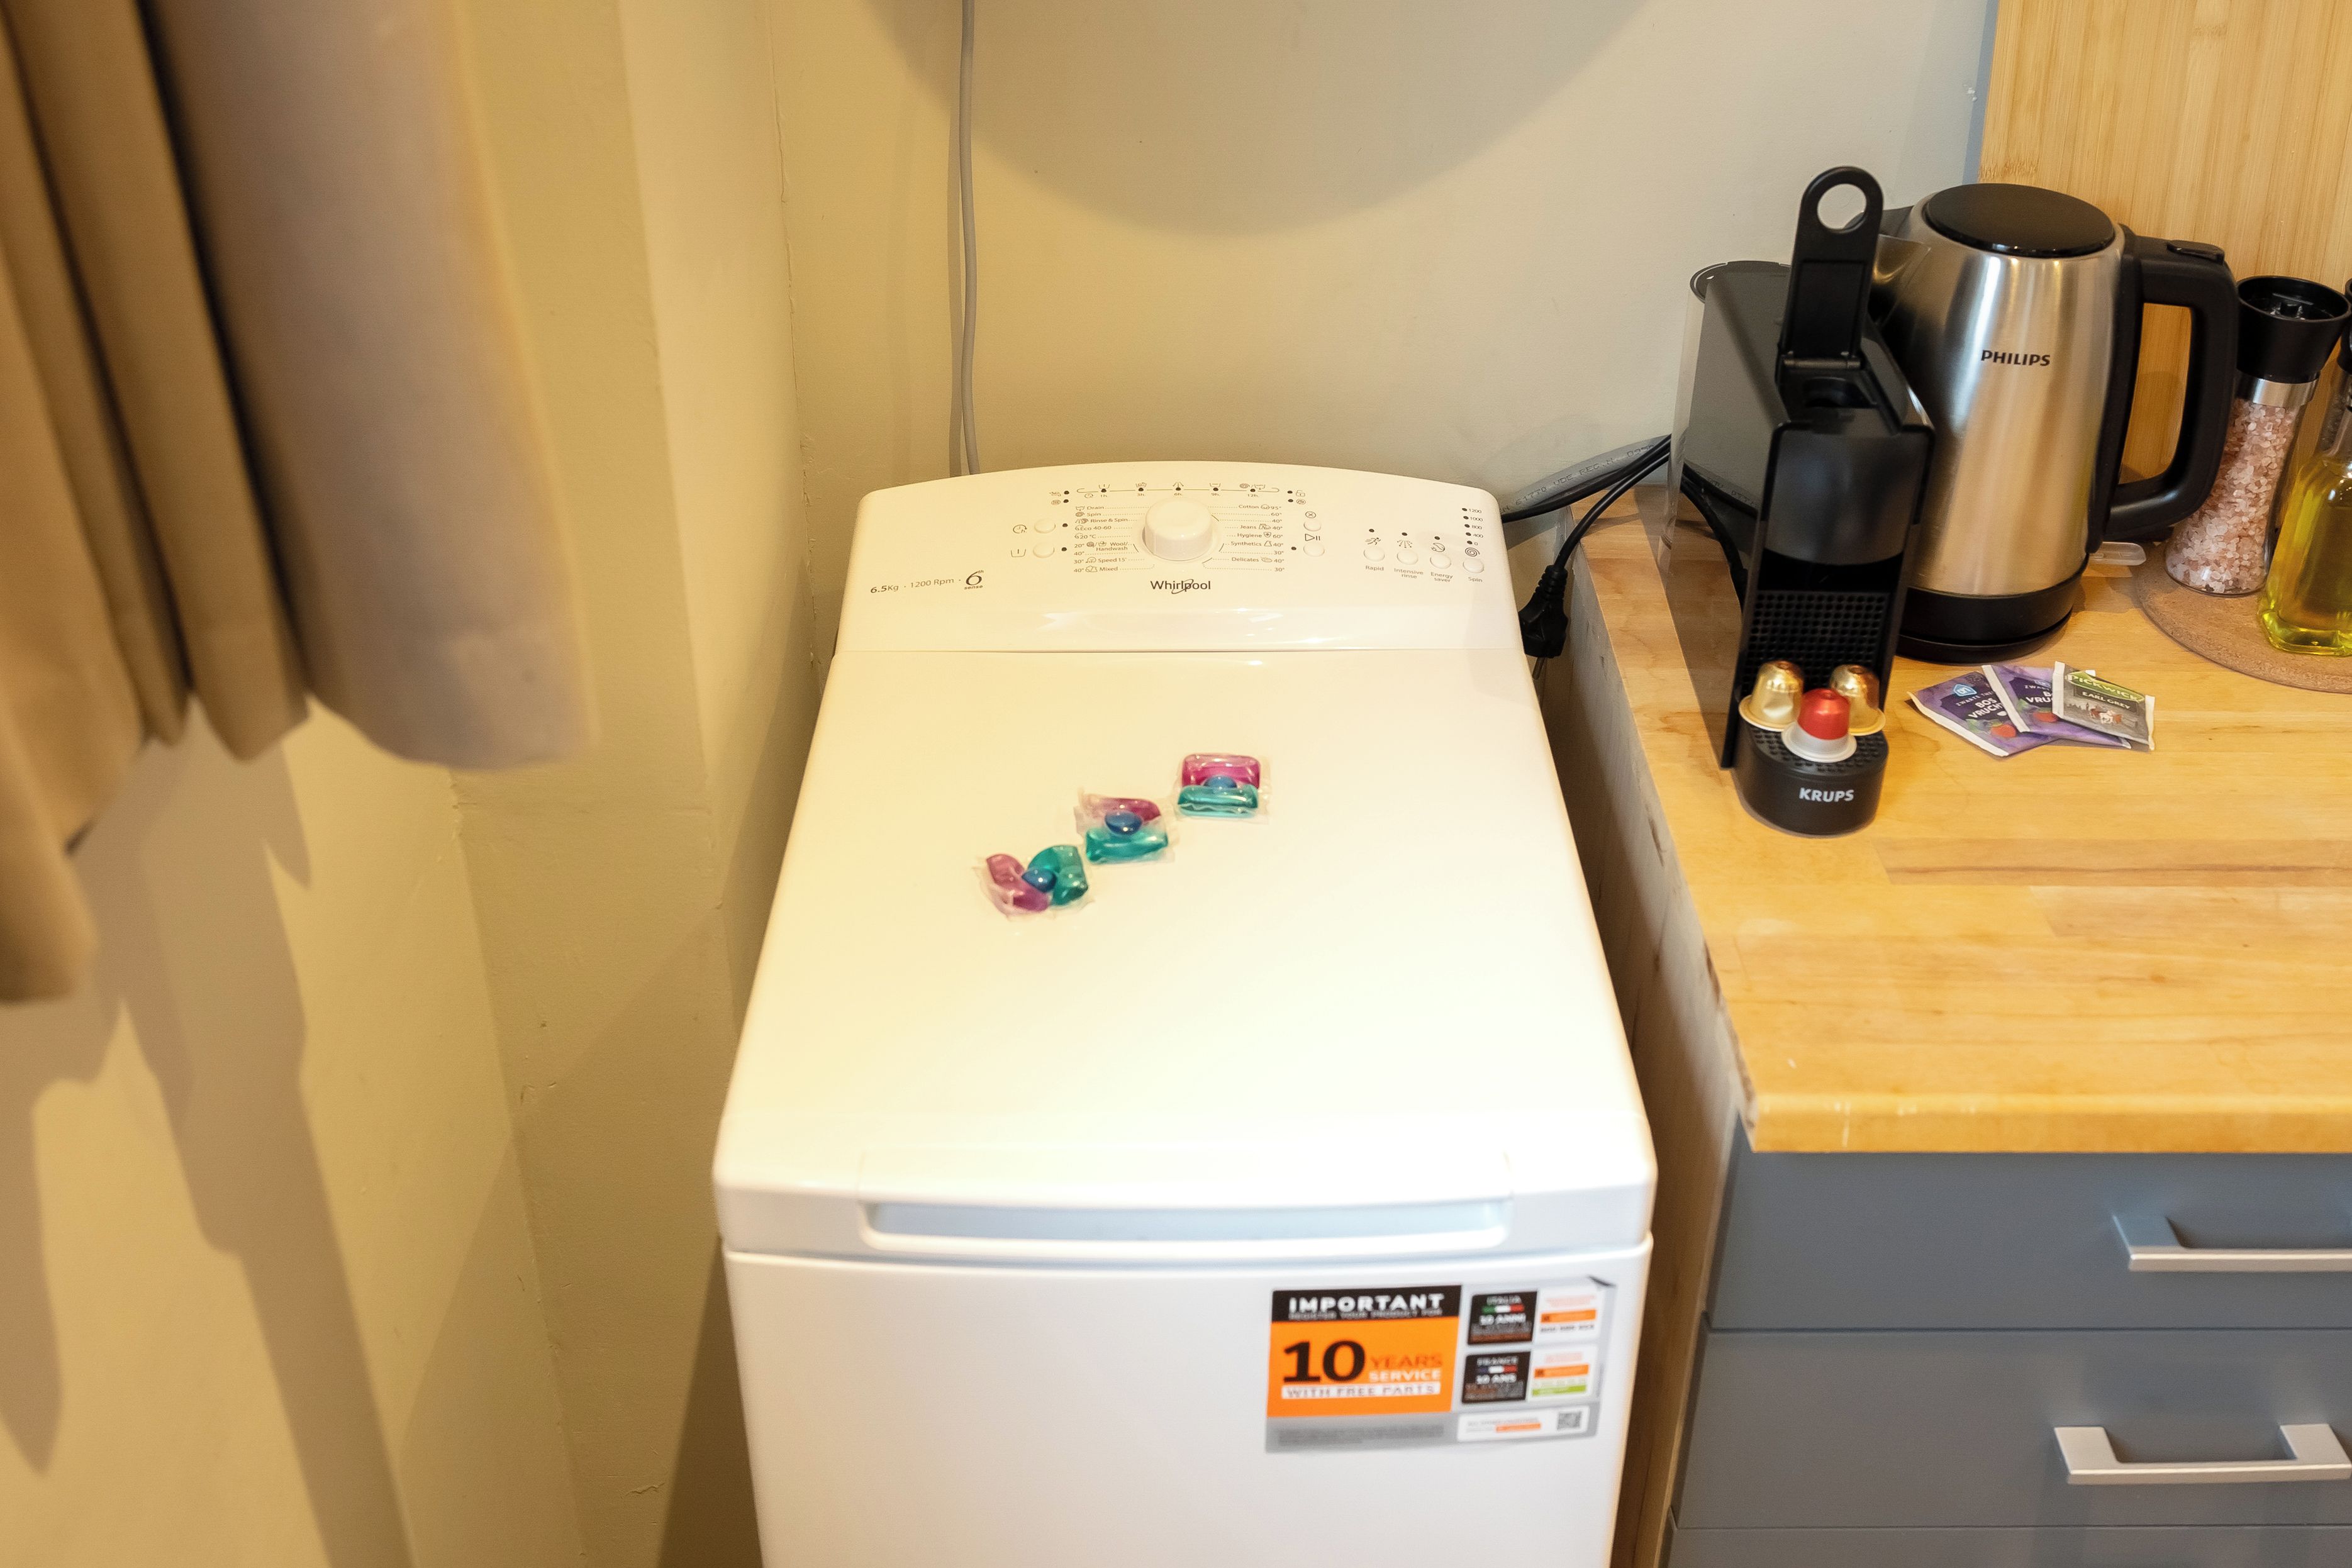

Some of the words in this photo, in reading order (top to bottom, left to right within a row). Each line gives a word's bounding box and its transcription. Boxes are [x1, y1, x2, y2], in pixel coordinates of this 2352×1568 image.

[1981, 349, 2051, 367] PHILIPS
[870, 585, 899, 593] 6.5Kg
[910, 580, 932, 588] 1200
[1150, 579, 1211, 593] Whirlpool
[2068, 674, 2138, 701] PICKWICK
[1955, 694, 1981, 706] ZWARTE
[1975, 698, 1997, 708] BOS
[2082, 691, 2106, 702] EARL
[2107, 698, 2131, 709] GREY
[1798, 787, 1855, 803] KRUPS
[1289, 1293, 1445, 1314] IMPORTANT
[1283, 1340, 1366, 1383] 10
[1370, 1354, 1443, 1369] YEARS
[1369, 1368, 1442, 1383] SERVICE
[1287, 1387, 1330, 1398] WITH
[1337, 1387, 1374, 1396] FREE
[1383, 1385, 1435, 1396] PARTS
